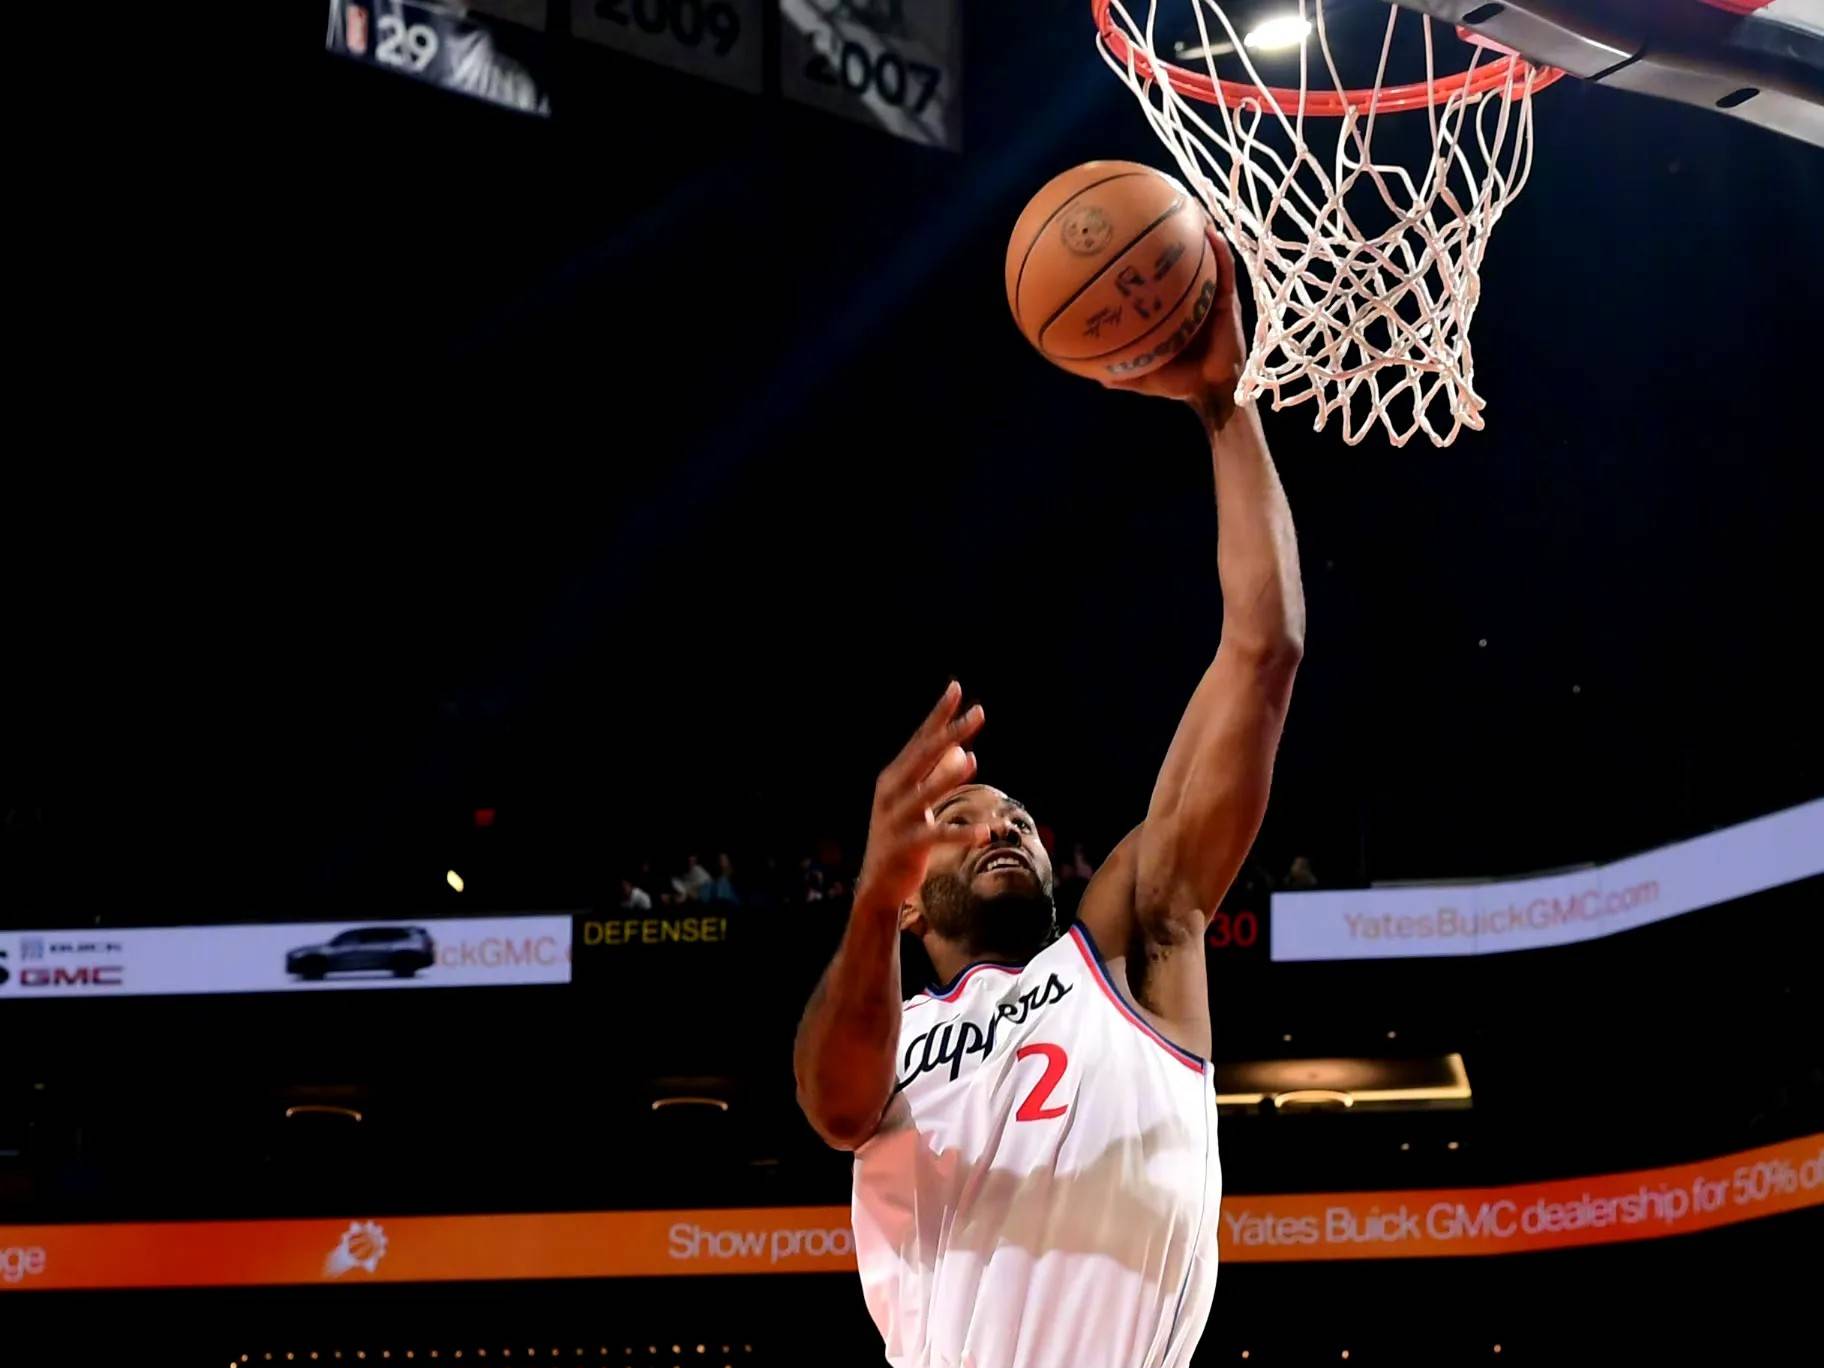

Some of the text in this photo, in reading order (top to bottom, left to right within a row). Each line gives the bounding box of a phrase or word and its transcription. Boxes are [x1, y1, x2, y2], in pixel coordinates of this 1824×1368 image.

[374, 14, 438, 72] 29
[583, 917, 727, 946] DEFENSE!
[1344, 880, 1659, 941] YatesBuickGMC.com
[20, 965, 123, 986] GMC
[1016, 1042, 1068, 1122] 2
[668, 1222, 768, 1259] Show
[771, 1227, 857, 1264] proo
[1225, 1210, 1320, 1246] Yates
[1325, 1205, 1421, 1244] Buick
[1426, 1199, 1517, 1240] GMC
[1521, 1184, 1689, 1234] dealership
[1693, 1175, 1729, 1215] for
[1733, 1159, 1798, 1206] 50%
[0, 1247, 46, 1283] ge
